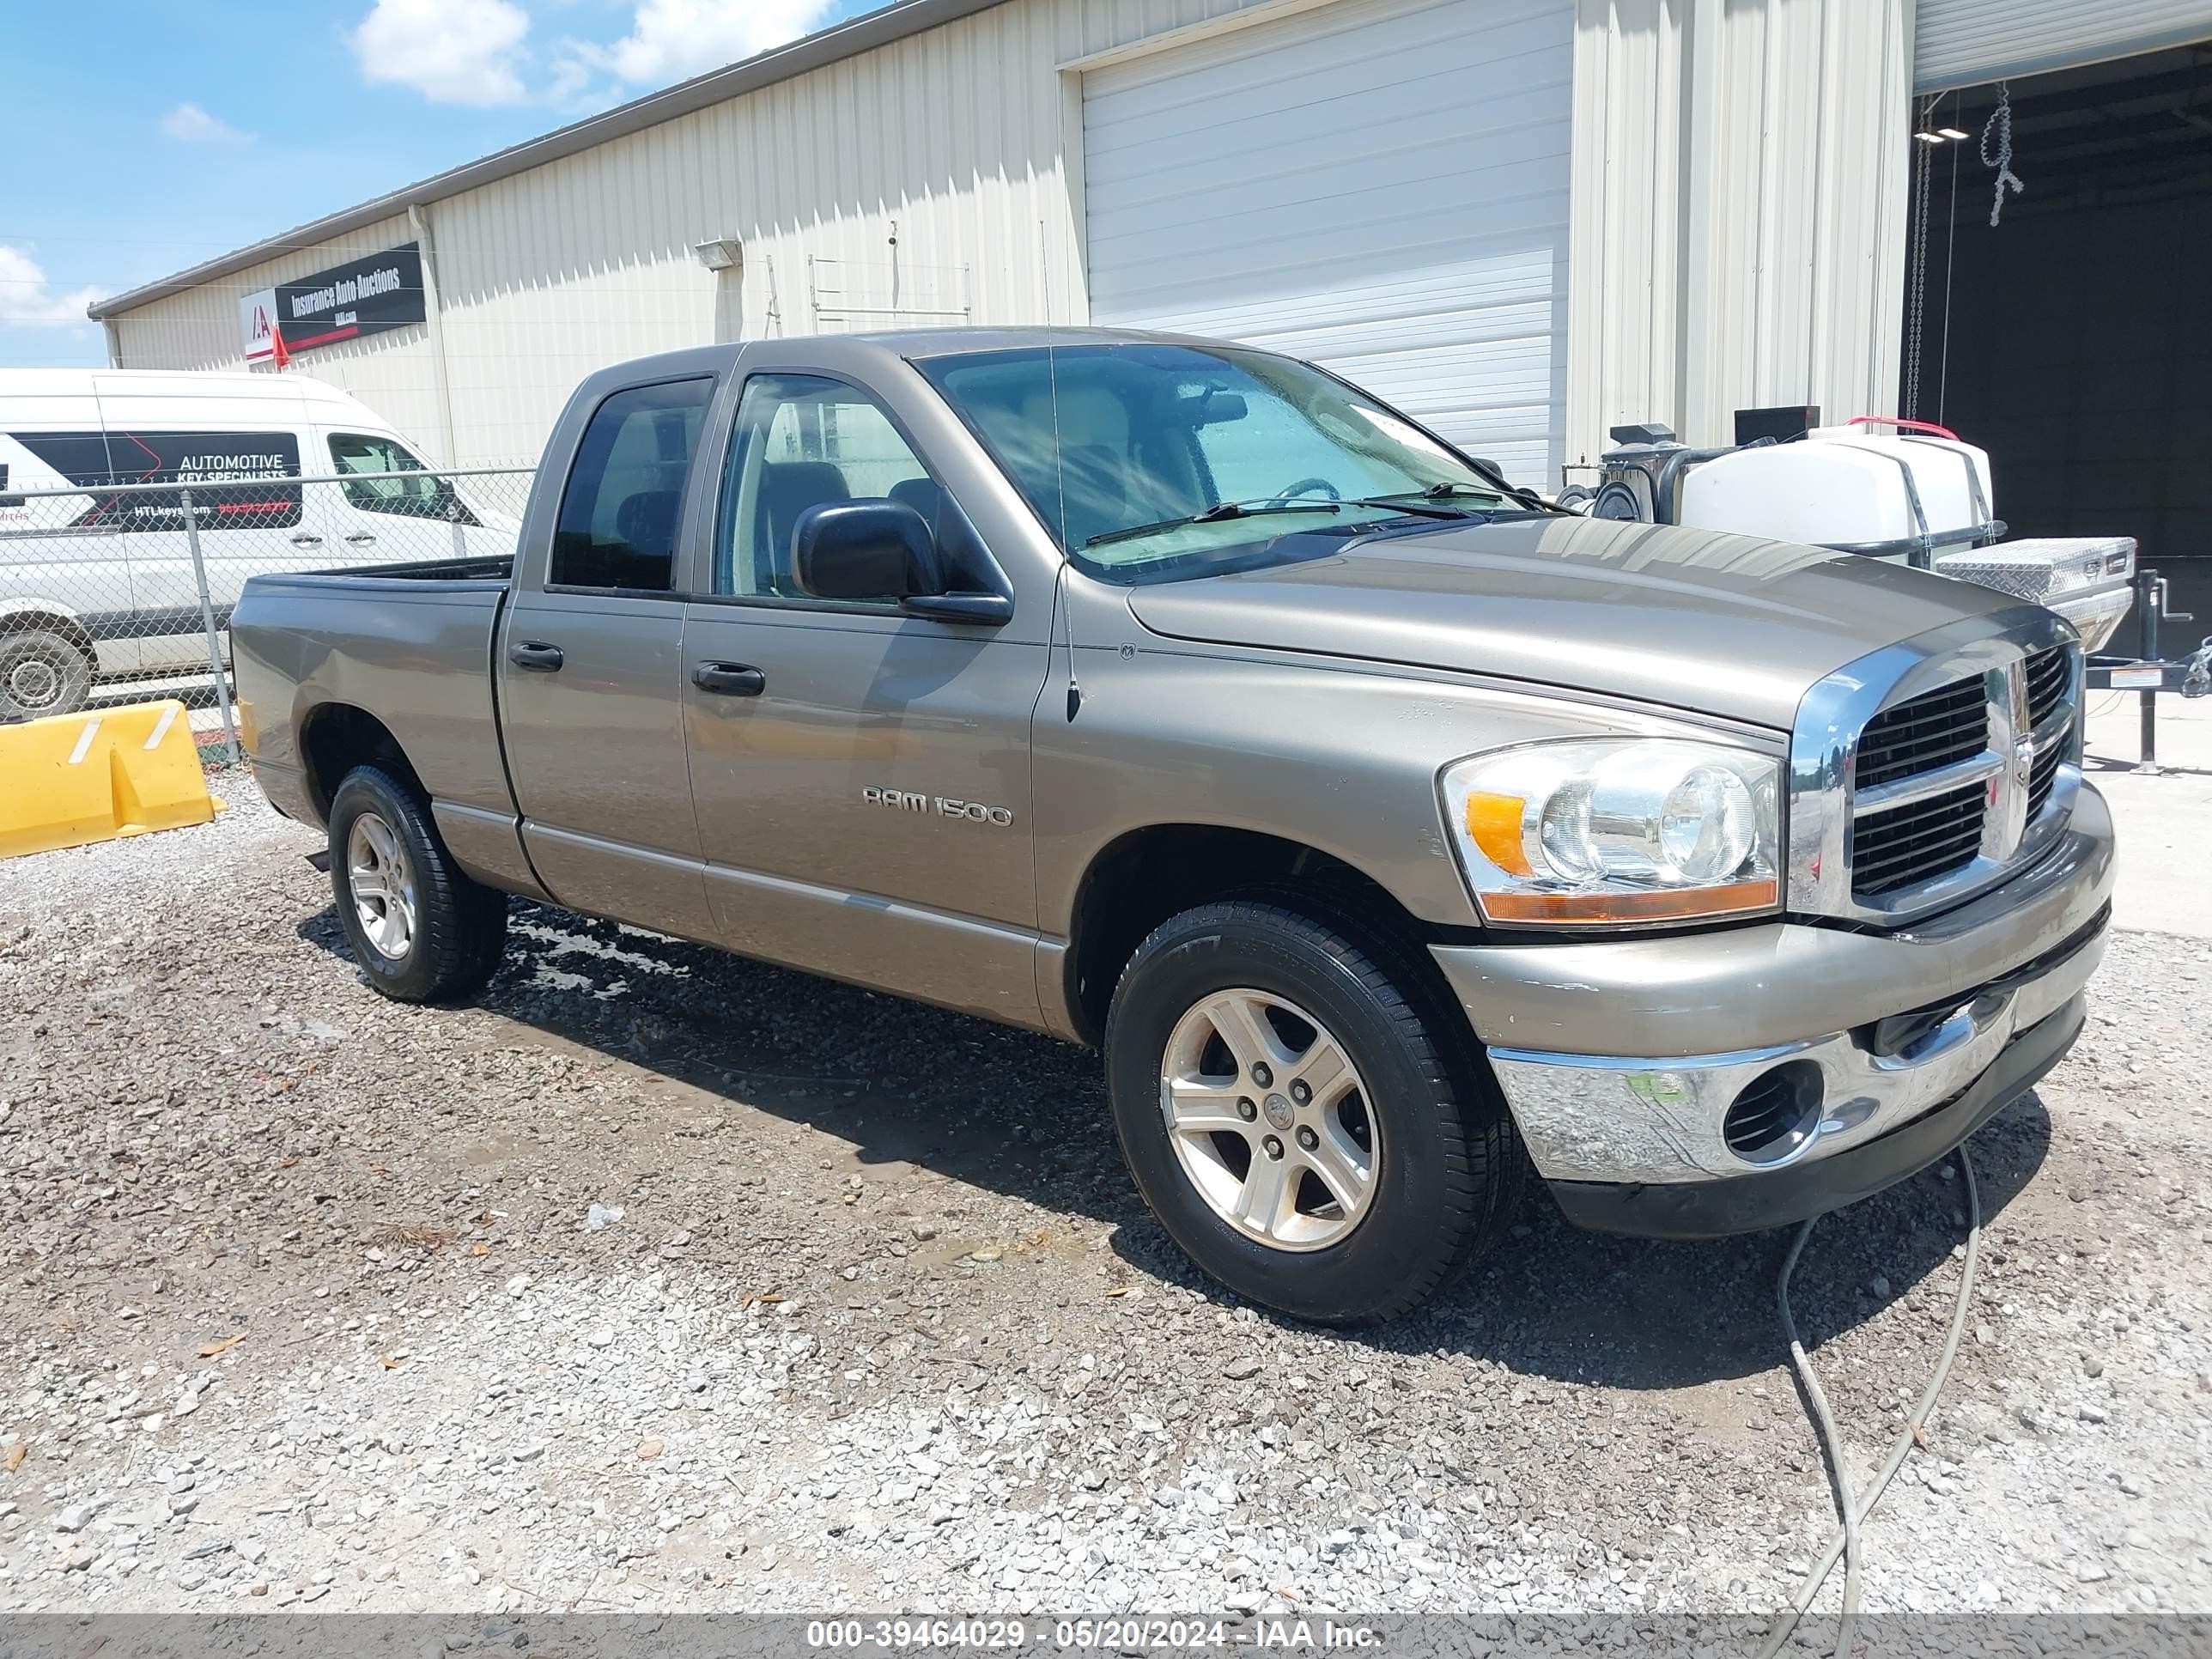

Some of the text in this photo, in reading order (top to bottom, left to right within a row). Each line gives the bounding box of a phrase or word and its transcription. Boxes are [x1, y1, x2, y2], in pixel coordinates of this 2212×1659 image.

[292, 267, 400, 318] Insurance Auto Auctions
[180, 454, 283, 471] AUTOMOTIVE
[178, 470, 286, 483] KEY SPECIALISTS
[135, 505, 210, 518] HTLkeysom
[862, 786, 1014, 828] RAM 1500
